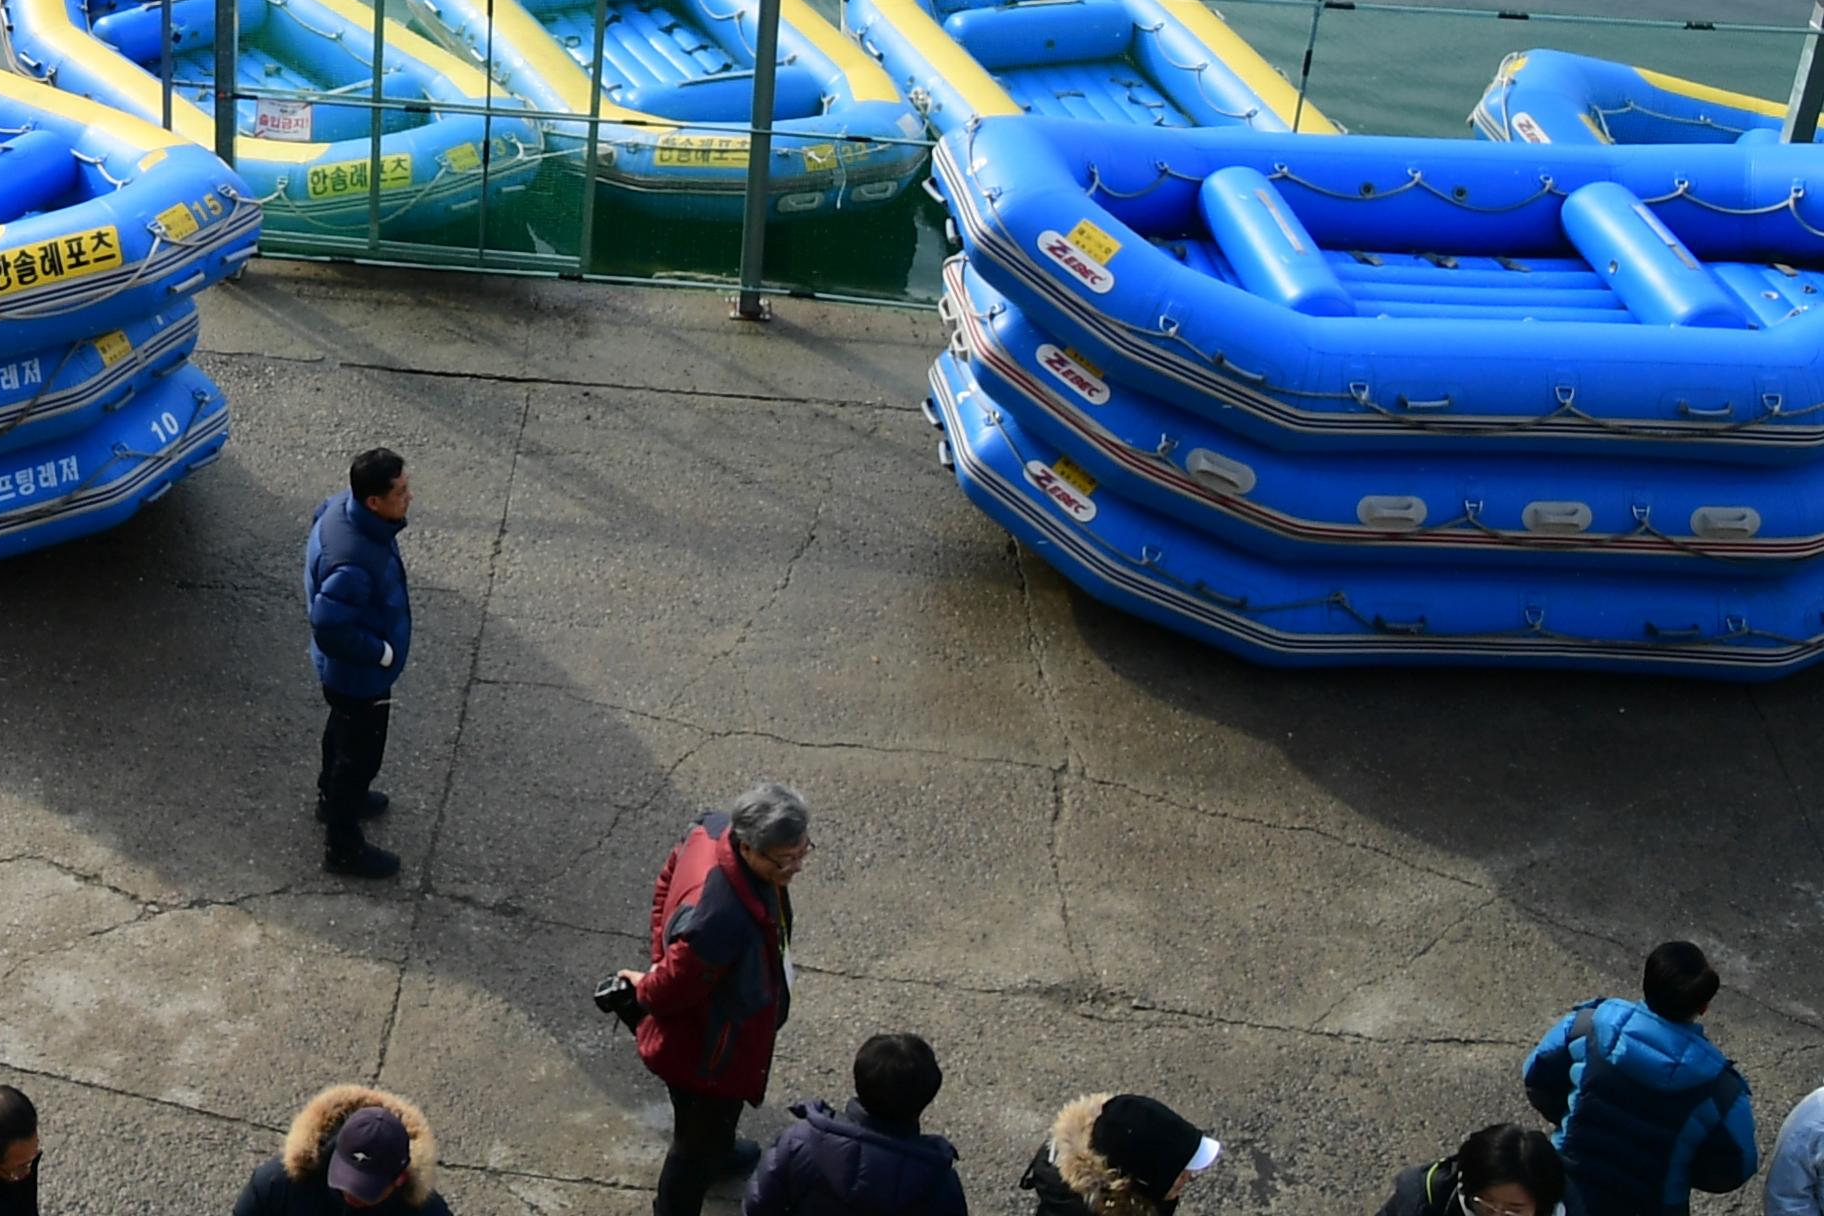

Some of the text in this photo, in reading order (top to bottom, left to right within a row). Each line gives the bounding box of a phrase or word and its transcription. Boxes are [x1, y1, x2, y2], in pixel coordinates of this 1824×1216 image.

[258, 111, 309, 130] 출입금지!
[192, 193, 224, 222] 15
[1045, 238, 1106, 285] ZEBEC
[1043, 351, 1103, 398] ZEBEC
[149, 411, 180, 443] 10
[1035, 468, 1090, 515] ZEBEC
